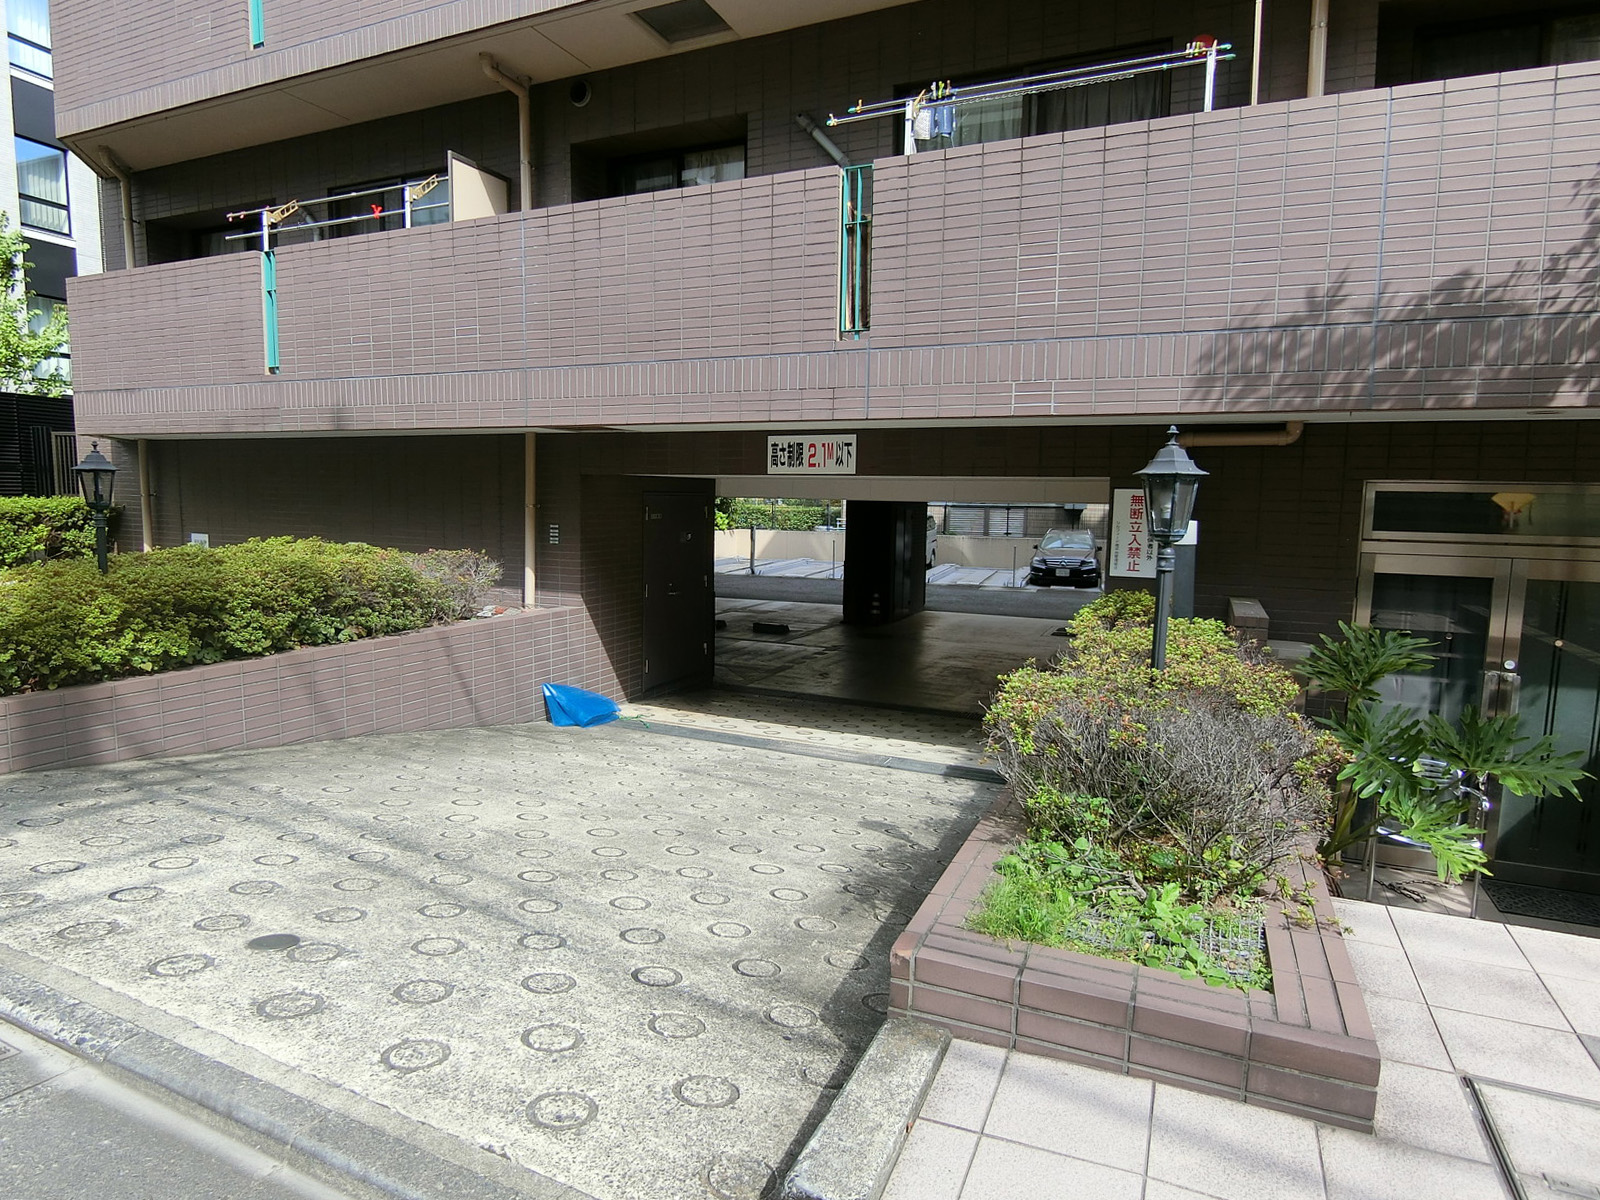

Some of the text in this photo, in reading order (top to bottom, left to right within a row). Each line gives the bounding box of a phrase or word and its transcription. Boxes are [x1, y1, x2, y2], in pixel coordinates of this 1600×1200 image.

[771, 441, 853, 468] 高さ制限2.1M以下
[1126, 495, 1145, 572] 無断立入禁止
